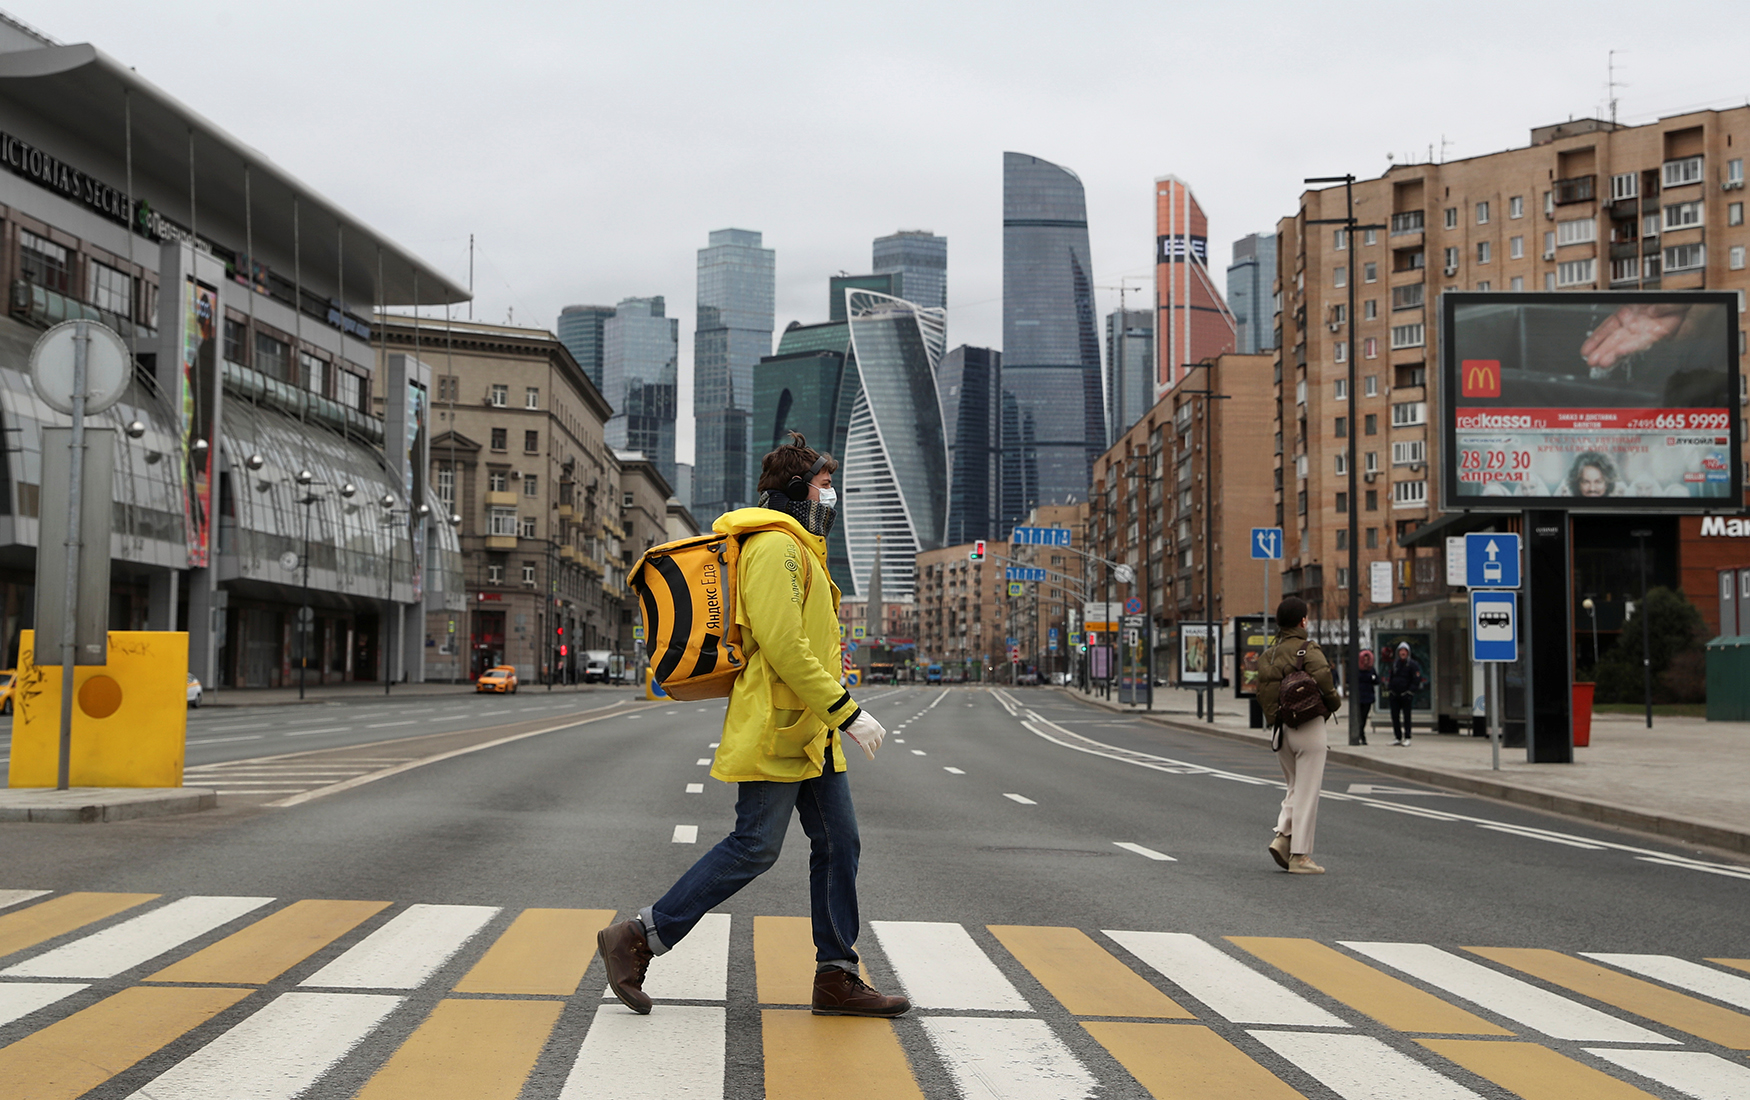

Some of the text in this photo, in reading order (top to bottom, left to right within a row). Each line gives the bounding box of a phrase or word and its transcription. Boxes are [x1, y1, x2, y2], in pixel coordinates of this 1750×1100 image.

[1656, 414, 1685, 428] 665
[1689, 414, 1729, 429] 9999
[1461, 450, 1531, 469] 28 29 30
[1461, 471, 1523, 484] апреля
[701, 564, 721, 629] Яндекс Еда
